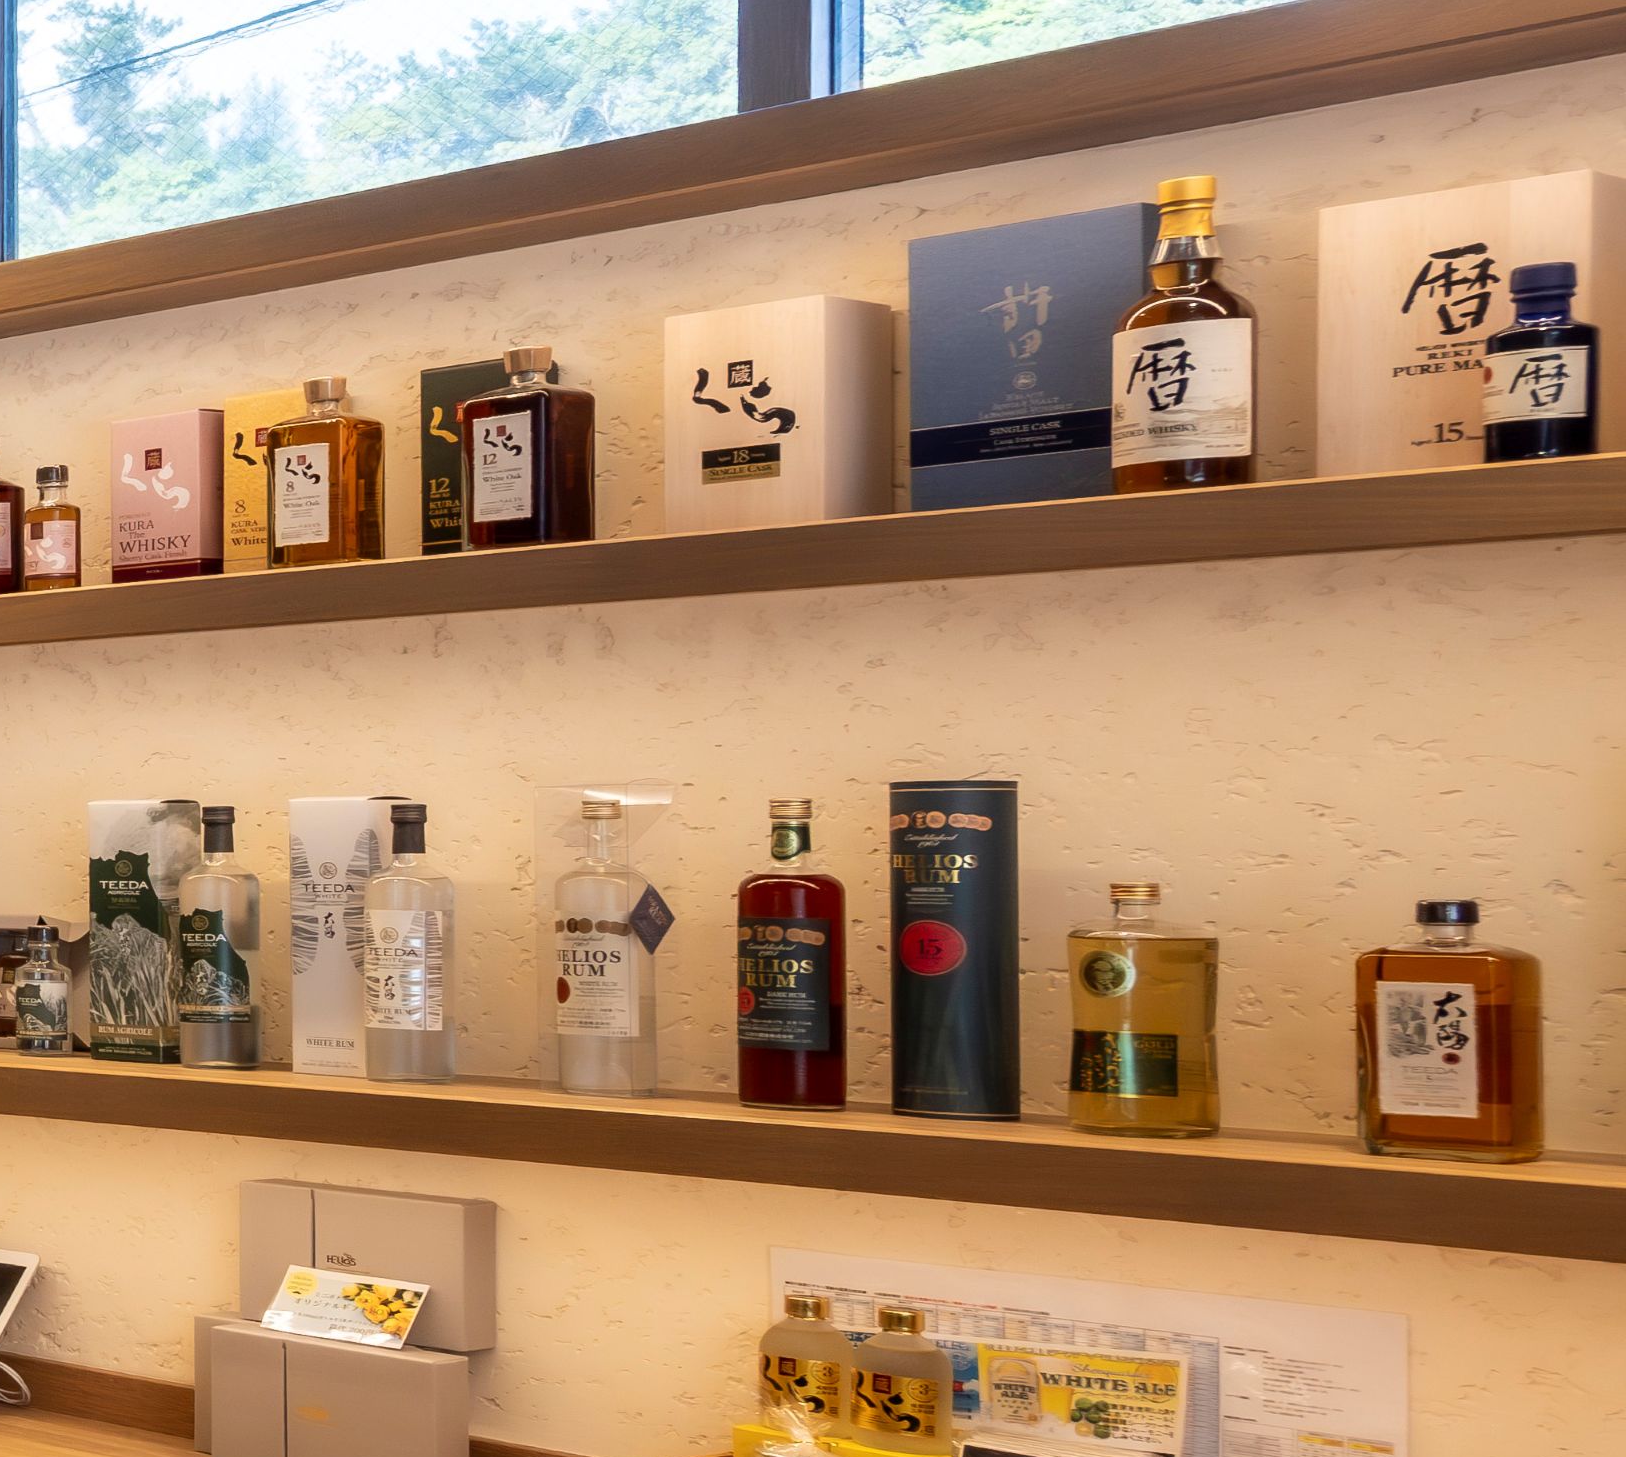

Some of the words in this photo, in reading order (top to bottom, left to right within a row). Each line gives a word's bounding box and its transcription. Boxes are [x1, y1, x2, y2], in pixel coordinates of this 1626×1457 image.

[1401, 242, 1501, 336] 暦
[1427, 349, 1474, 360] REKI
[1126, 338, 1197, 412] 暦
[1392, 361, 1446, 378] PURE
[1452, 358, 1484, 371] MA
[1509, 354, 1570, 407] 暦
[1433, 422, 1464, 443] 15
[482, 453, 497, 466] 12
[429, 477, 450, 494] 12
[118, 520, 155, 533] KURA
[119, 534, 191, 555] WHISKY
[904, 869, 960, 884] RUM
[99, 880, 149, 890] TEEDA
[302, 883, 355, 893] TEEDA
[182, 933, 226, 942] TEEDA
[368, 948, 418, 957] TEEDA
[562, 964, 606, 977] RUM
[746, 974, 797, 988] RUM
[306, 1038, 334, 1048] WHITE
[336, 1040, 355, 1048] RUM
[1040, 1373, 1129, 1393] WHITE
[1134, 1384, 1177, 1396] ALE
